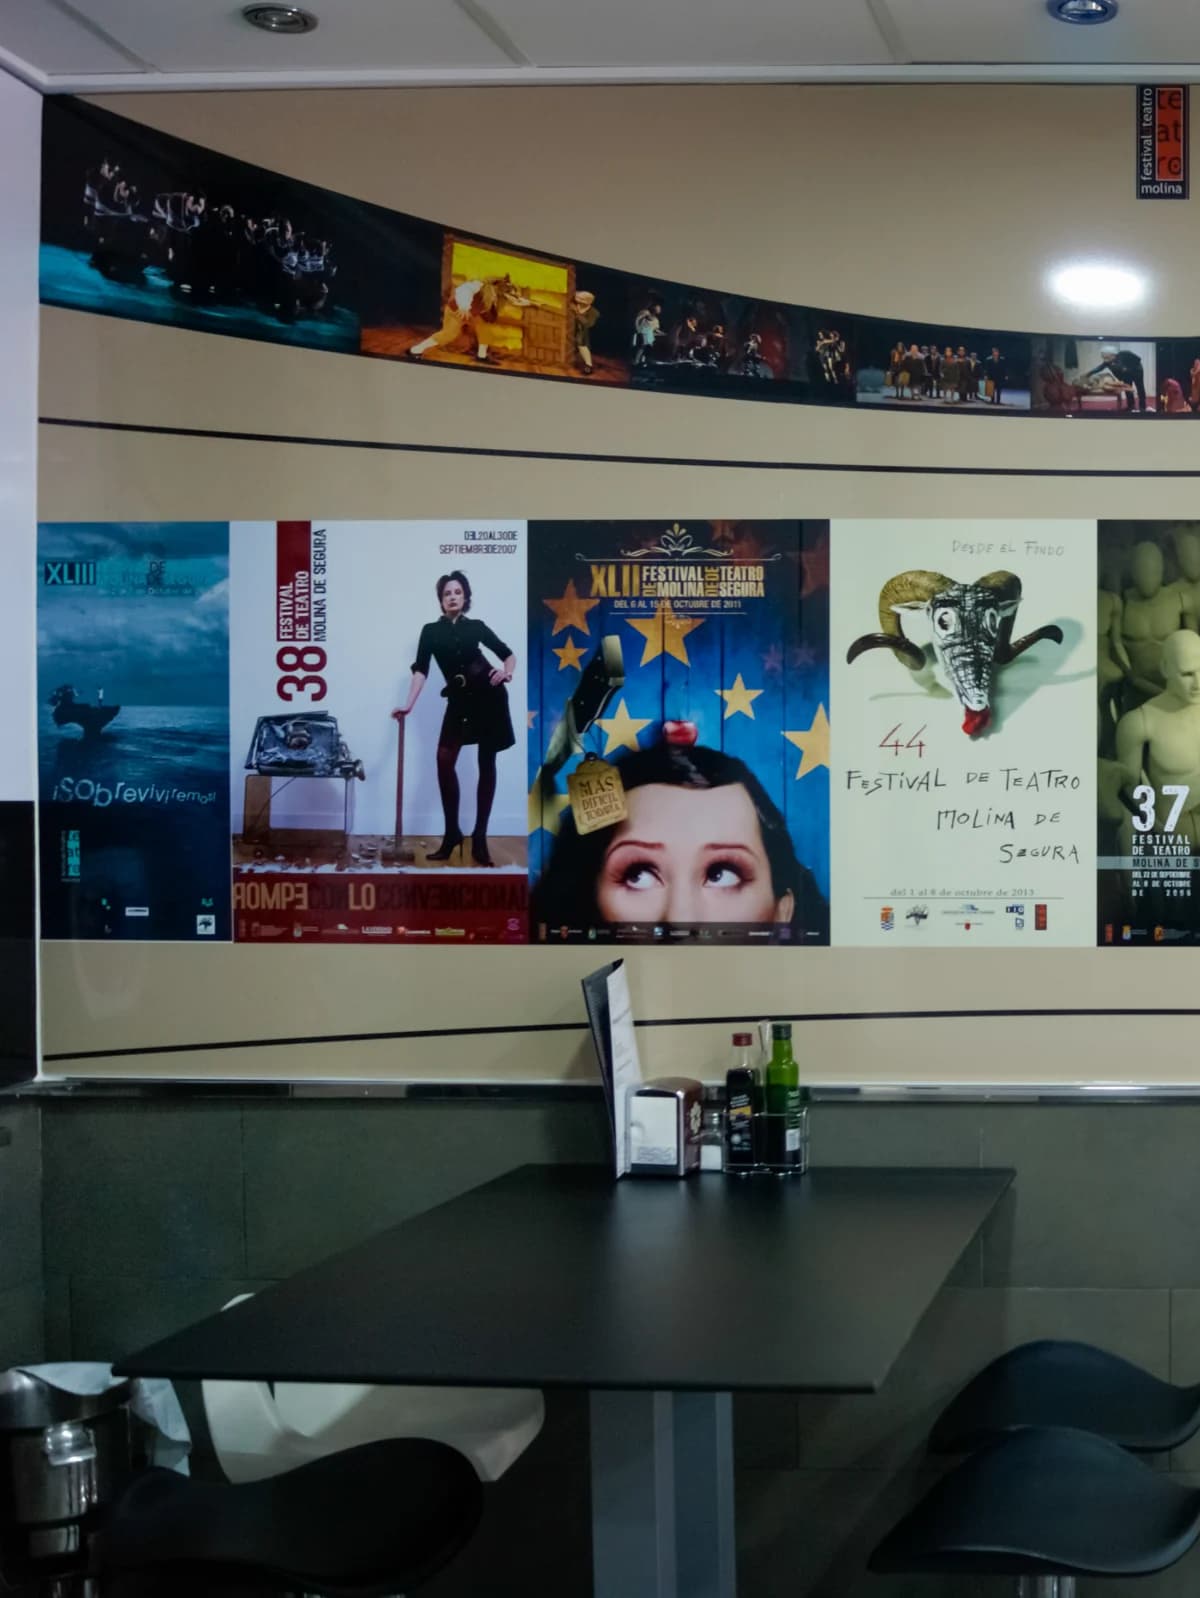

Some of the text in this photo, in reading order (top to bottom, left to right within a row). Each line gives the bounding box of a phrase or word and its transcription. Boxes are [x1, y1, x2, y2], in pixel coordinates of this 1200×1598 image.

[1140, 88, 1153, 180] festival teatro
[1141, 183, 1182, 195] molina
[46, 563, 95, 585] XLIII
[313, 528, 327, 642] MOLINA DE SEGURA
[590, 564, 642, 598] XLII
[642, 565, 705, 582] FESTIVAL
[719, 565, 765, 582] TEATRO
[657, 581, 705, 598] MOLINA
[719, 581, 766, 598] SEGURA
[279, 582, 294, 640] FESTIVAL
[295, 570, 310, 640] DE TEATRO
[673, 599, 709, 609] OCTUBRE
[276, 646, 328, 702] 38
[878, 722, 928, 758] 44
[966, 771, 991, 785] DE
[1000, 767, 1081, 791] TEATRO
[1034, 811, 1062, 826] DE
[1131, 784, 1191, 833] 37
[1131, 845, 1191, 856] DE TEATRO
[1132, 834, 1191, 845] FESTIVAL
[1132, 858, 1171, 868] MOLINA
[1175, 858, 1188, 868] DE
[347, 882, 377, 911] LO
